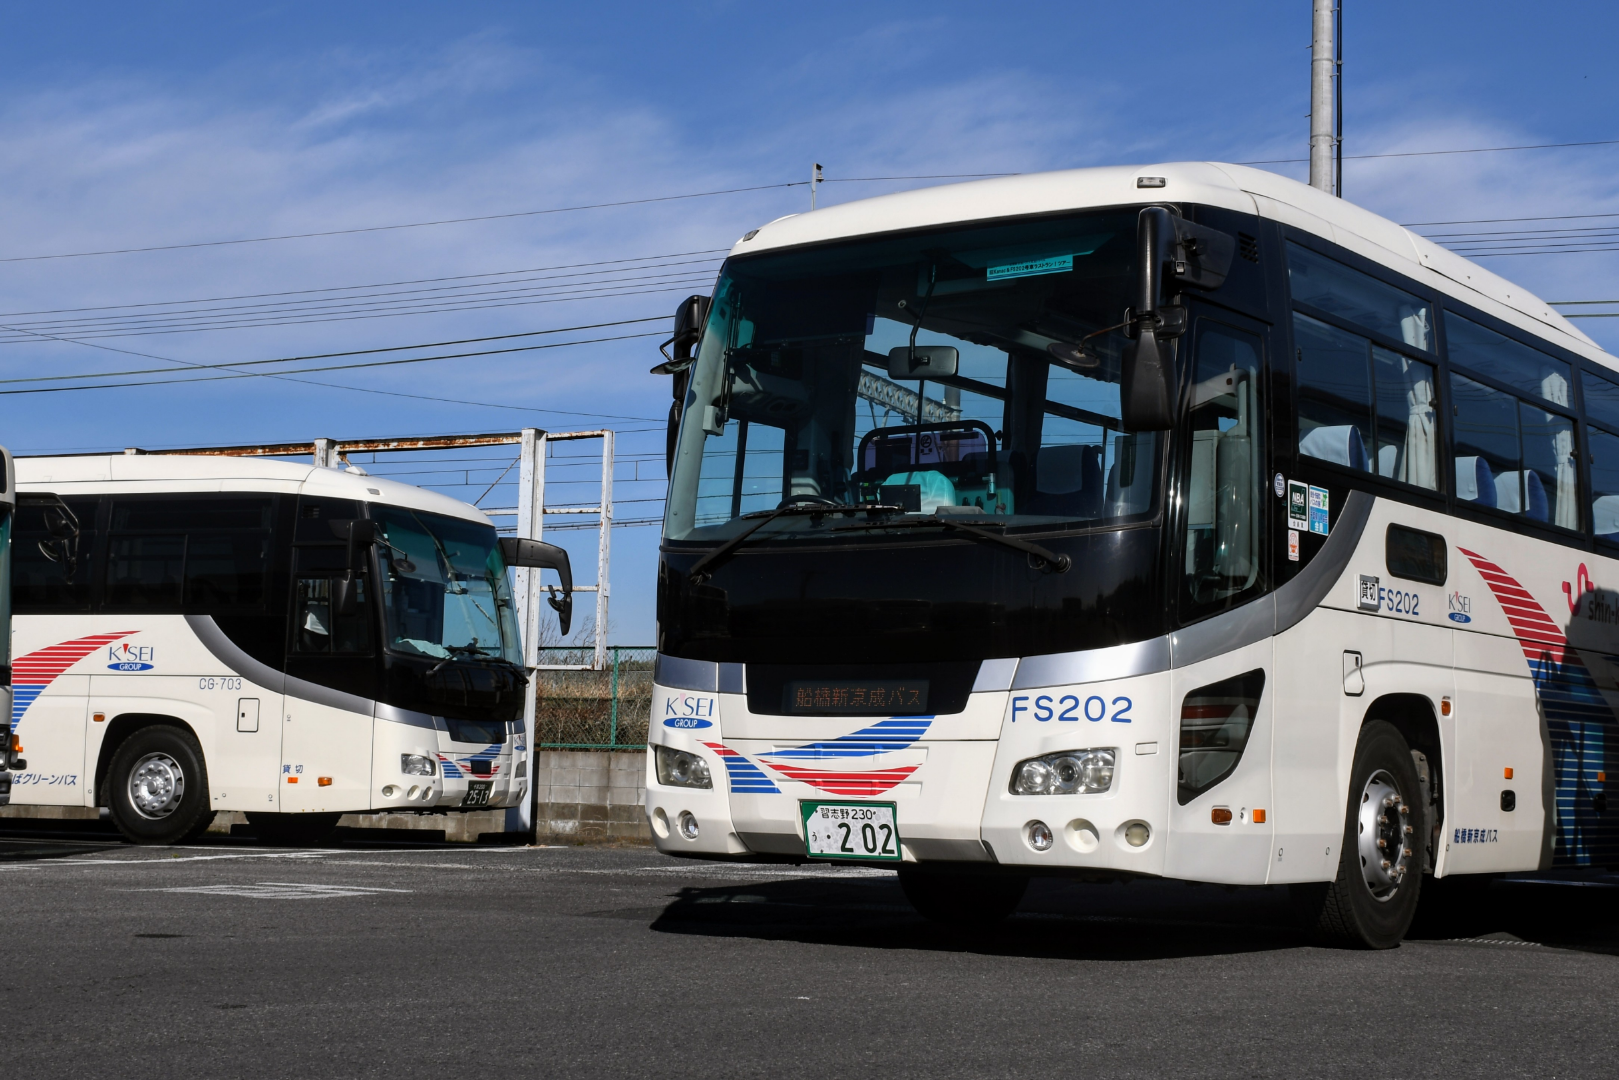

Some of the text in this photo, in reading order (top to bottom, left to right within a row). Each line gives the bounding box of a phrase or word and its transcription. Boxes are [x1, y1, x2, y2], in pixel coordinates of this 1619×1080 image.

[1292, 491, 1305, 505] NBA
[1361, 580, 1376, 601] 貸切
[1379, 587, 1420, 616] FS202
[1448, 591, 1471, 614] K'SEI
[1453, 613, 1466, 623] GROUP
[108, 643, 154, 662] K'SEI
[119, 662, 142, 671] GROUP
[199, 677, 242, 691] CG-703
[665, 692, 714, 717] K'SEI
[795, 686, 920, 707] 船橋新京成バス
[1011, 695, 1133, 724] FS202
[674, 718, 698, 728] GROUP
[11, 773, 77, 785] ばグリーンバス
[466, 789, 489, 804] 25-13
[1453, 827, 1498, 844] 船橋新京成バス
